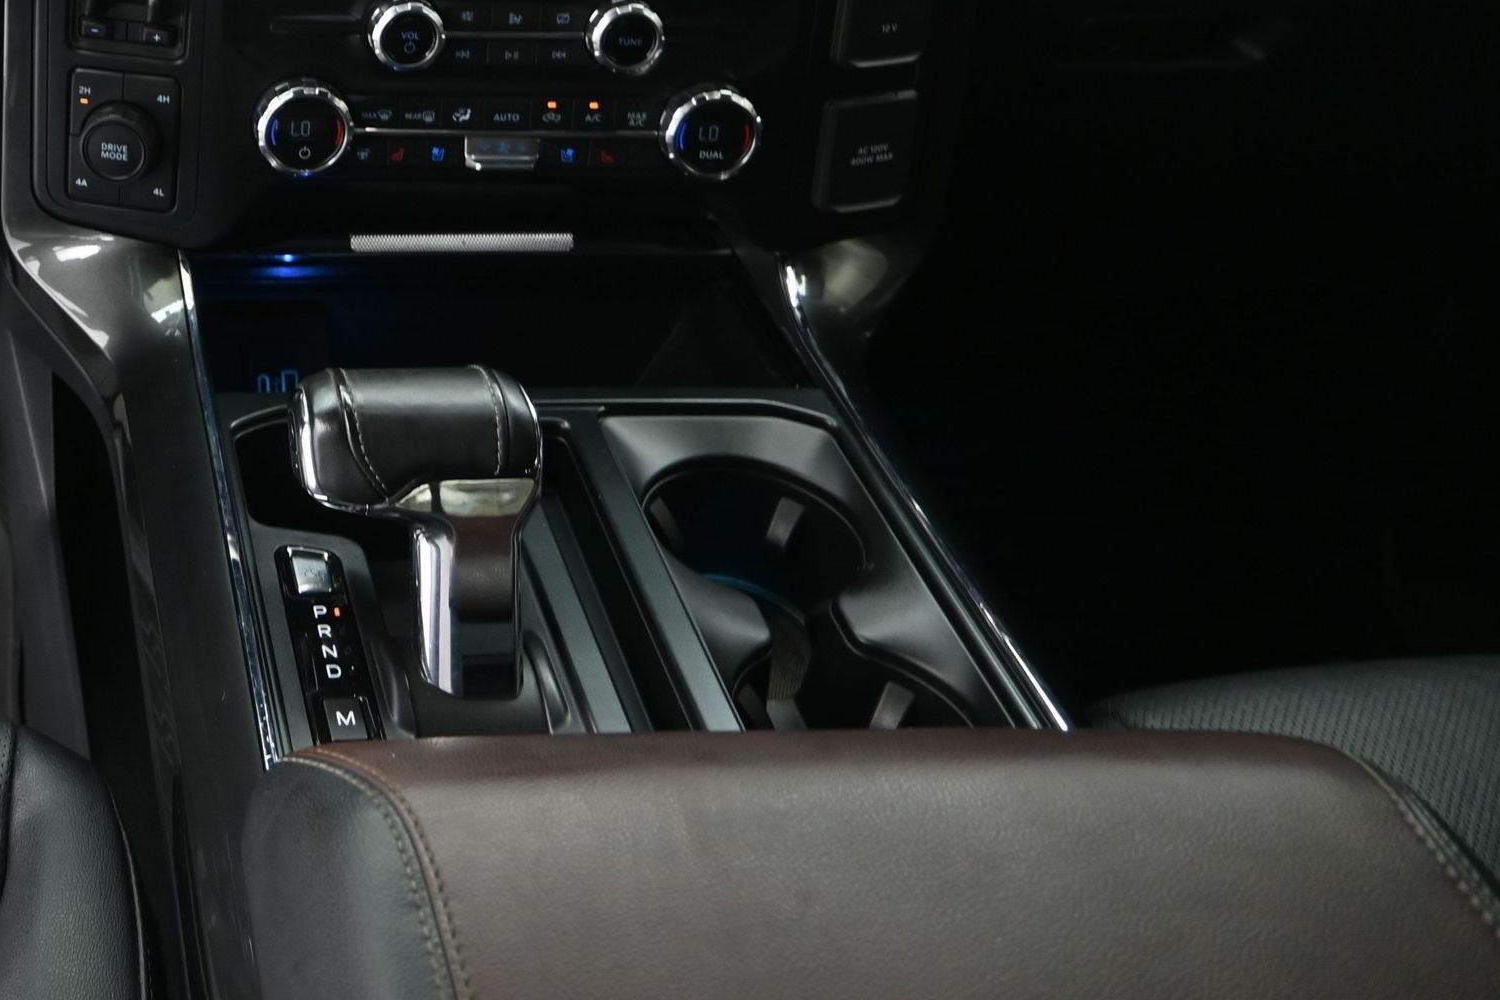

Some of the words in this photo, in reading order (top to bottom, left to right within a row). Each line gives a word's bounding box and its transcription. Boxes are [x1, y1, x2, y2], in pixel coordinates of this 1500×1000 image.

[401, 31, 420, 40] VOL
[618, 37, 643, 47] TUNE
[78, 86, 91, 95] 2H
[156, 94, 170, 104] 4H
[404, 112, 422, 120] REAR
[494, 112, 520, 122] AUTO
[585, 113, 602, 122] A/C
[627, 111, 647, 119] MAX
[629, 119, 645, 127] A/C
[101, 142, 128, 152] DRIVE
[101, 151, 128, 161] MODE
[699, 150, 724, 160] DUAL
[75, 178, 88, 187] 4A
[153, 187, 164, 197] 4L
[313, 605, 327, 619] P
[317, 624, 331, 638] R
[321, 644, 338, 659] N
[326, 664, 342, 678] D
[335, 710, 356, 726] M
